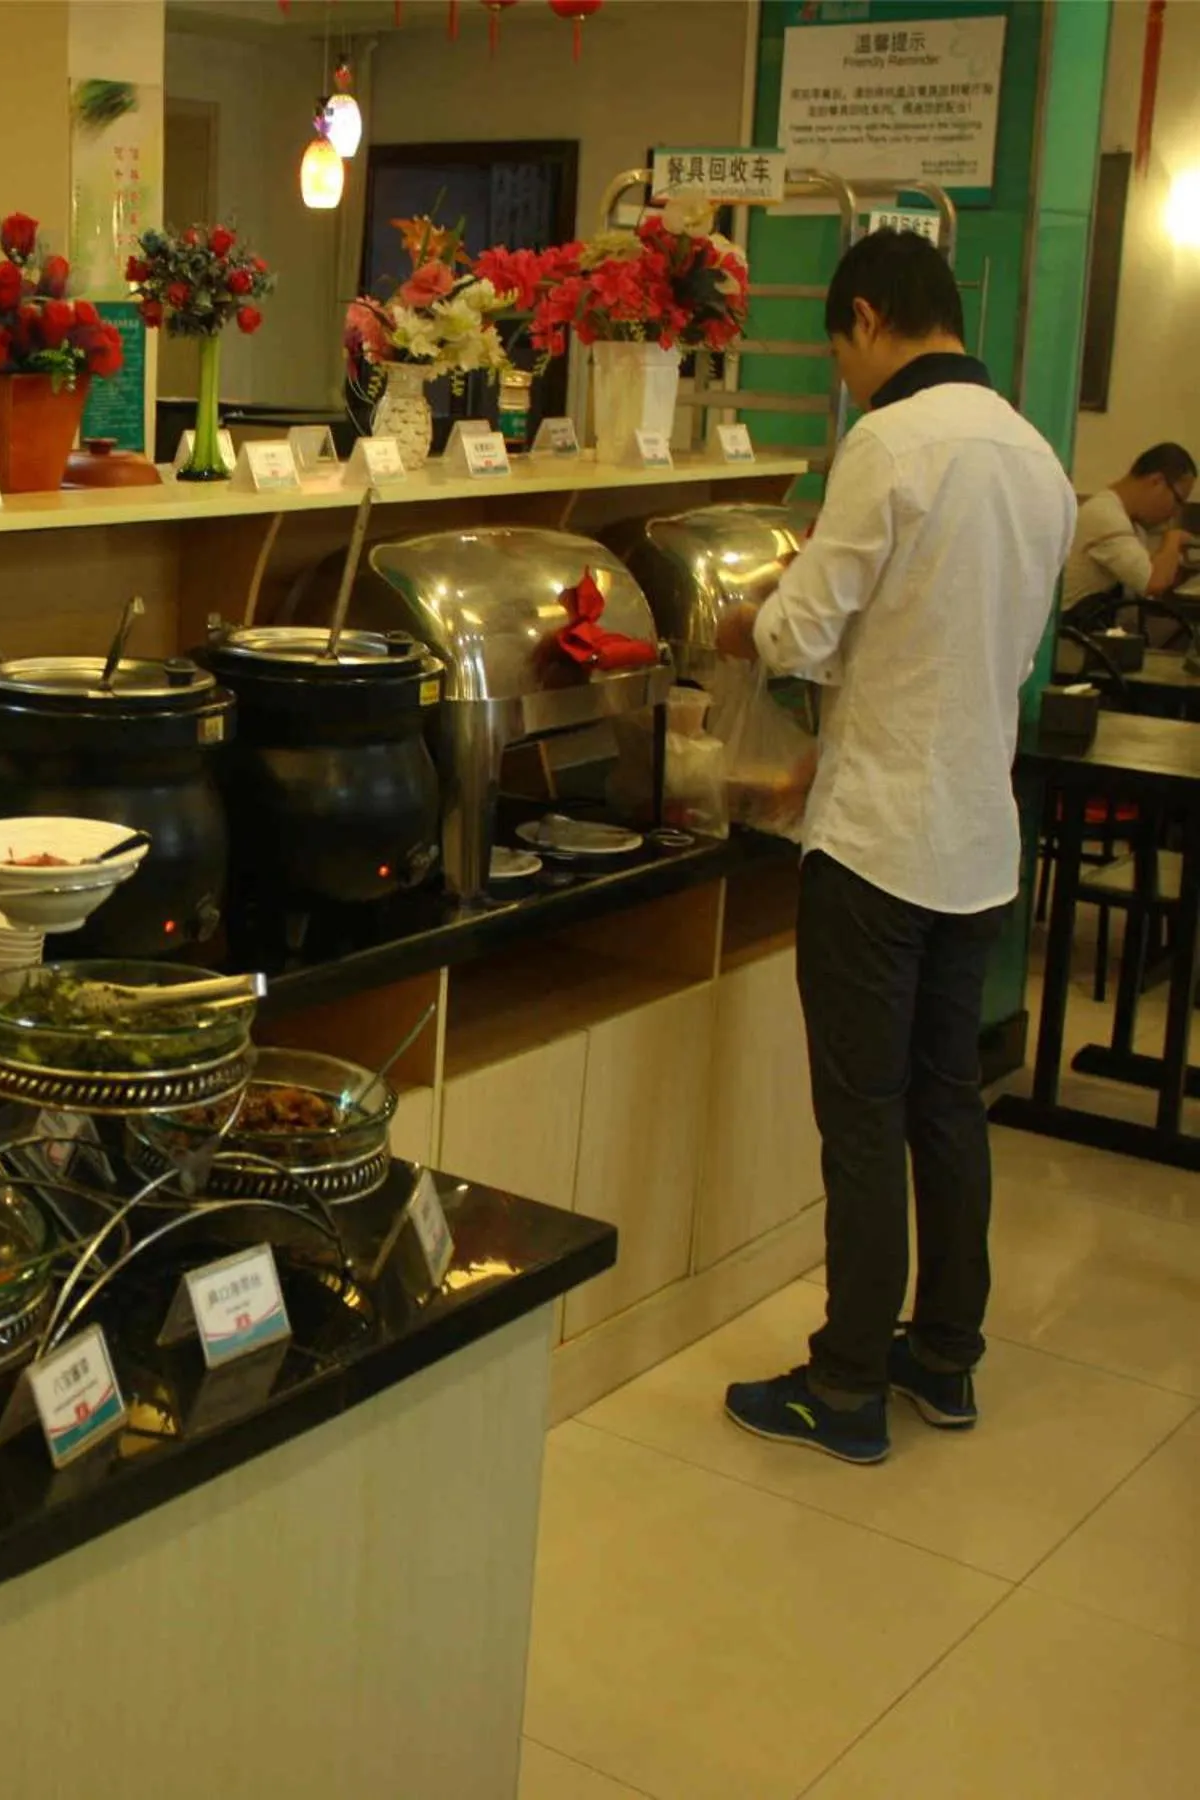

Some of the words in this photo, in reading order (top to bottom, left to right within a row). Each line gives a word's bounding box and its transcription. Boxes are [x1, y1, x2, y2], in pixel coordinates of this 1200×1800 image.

[854, 31, 926, 54] 温馨提示
[668, 156, 770, 184] 餐具回收车
